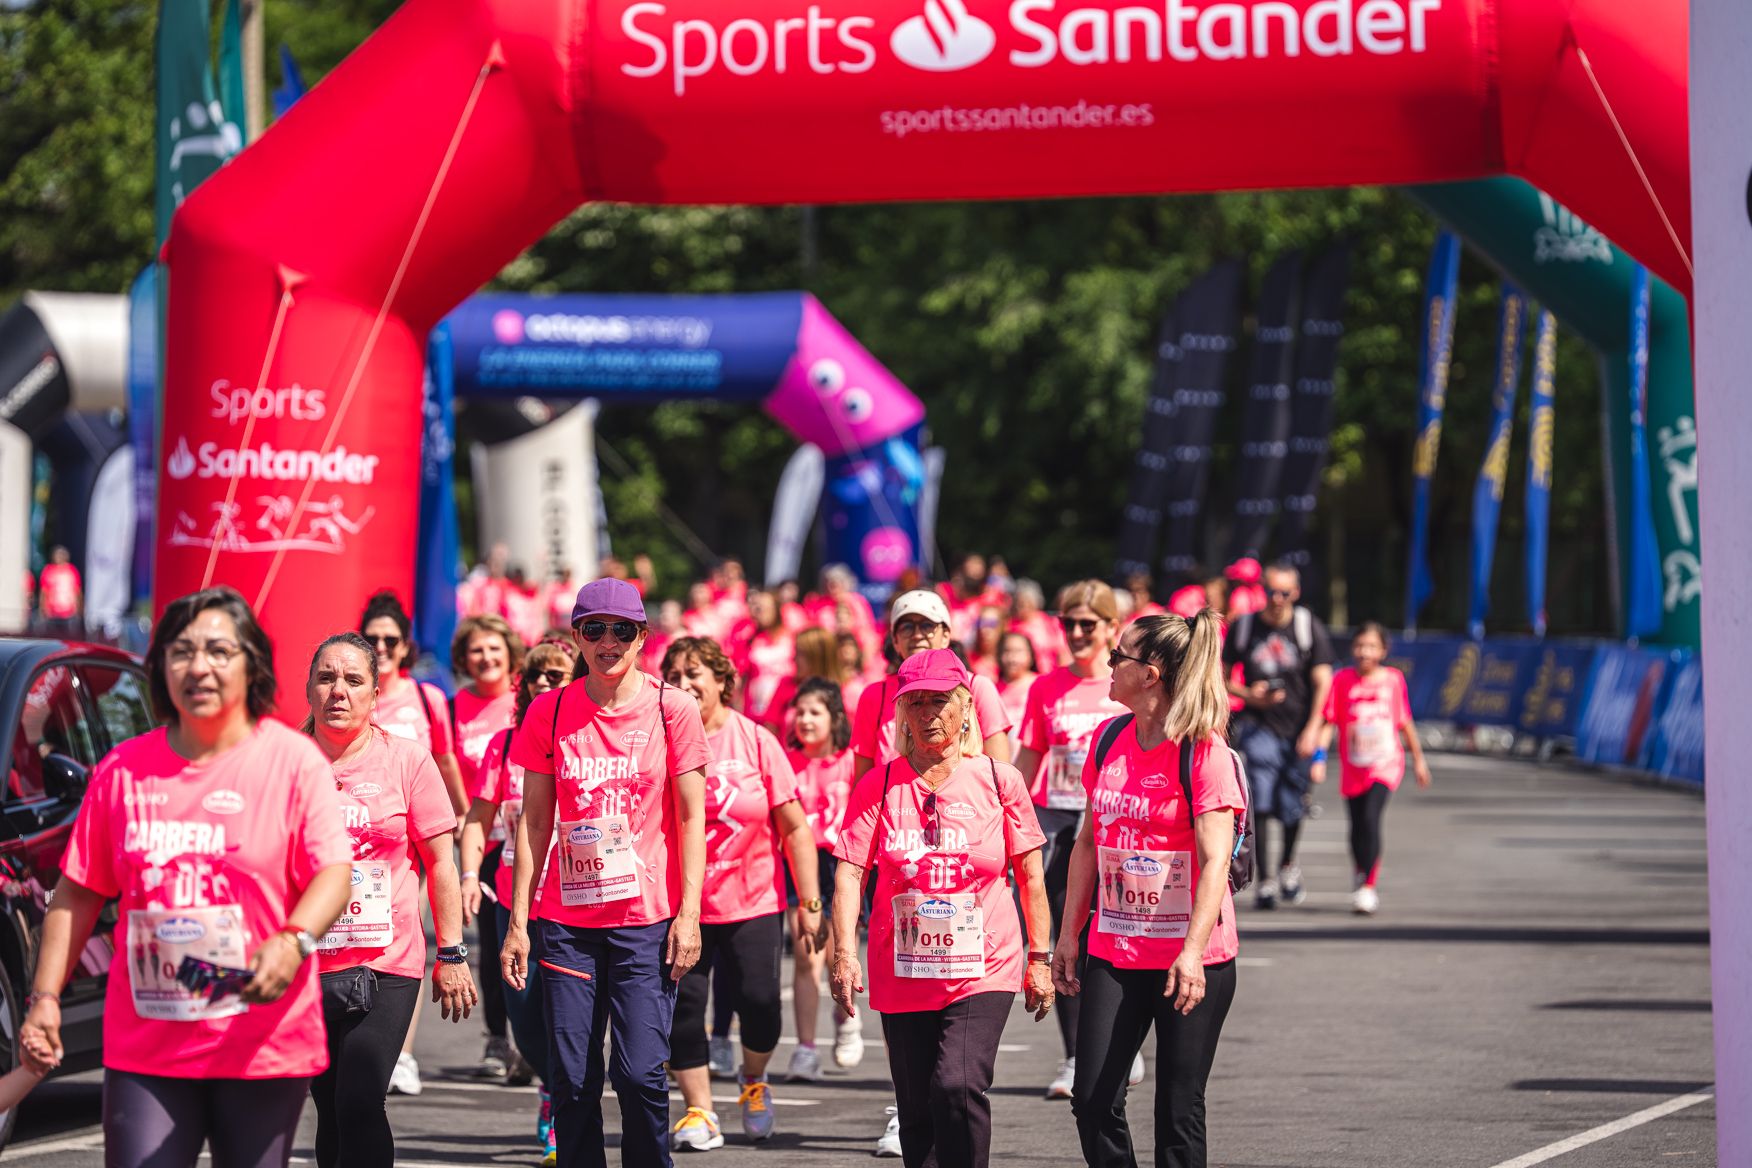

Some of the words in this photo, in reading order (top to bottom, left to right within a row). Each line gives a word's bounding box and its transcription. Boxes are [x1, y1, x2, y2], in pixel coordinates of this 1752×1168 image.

[620, 2, 876, 97] Sports
[1008, 0, 1442, 68] Santander
[880, 99, 1155, 138] sportssantander.es
[210, 379, 327, 426] Sports
[198, 441, 380, 484] Santander
[559, 734, 593, 744] OYSHO
[570, 833, 600, 841] ASTURIANA
[575, 857, 605, 873] 016
[1125, 863, 1159, 872] ASTURIANA
[929, 858, 957, 889] DE
[602, 888, 629, 897] Santander
[1125, 890, 1159, 905] 016
[920, 906, 954, 915] ASTURIANA
[1109, 922, 1135, 931] OYSHO
[920, 933, 954, 946] 016
[904, 965, 930, 973] OYSHO
